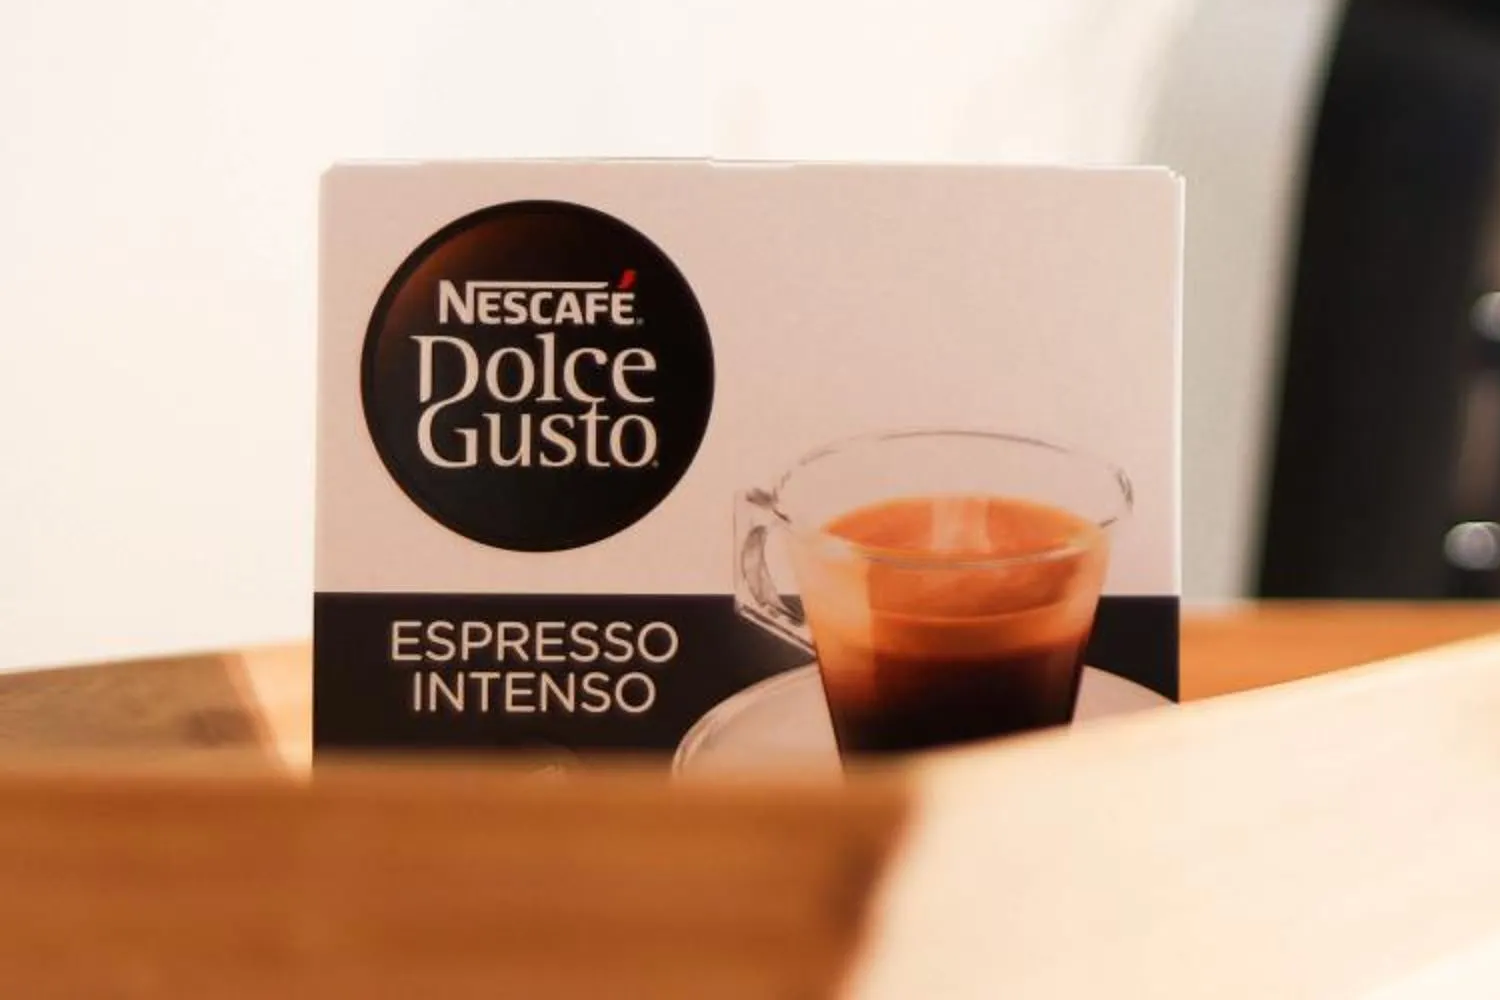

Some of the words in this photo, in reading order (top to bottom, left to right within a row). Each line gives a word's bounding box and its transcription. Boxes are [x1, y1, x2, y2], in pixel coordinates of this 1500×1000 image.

[438, 269, 636, 325] NESCAFÉ
[410, 332, 657, 403] Dolce
[416, 400, 657, 467] Gusto
[391, 620, 679, 662] ESPRESSO
[413, 671, 656, 713] INTENSO
